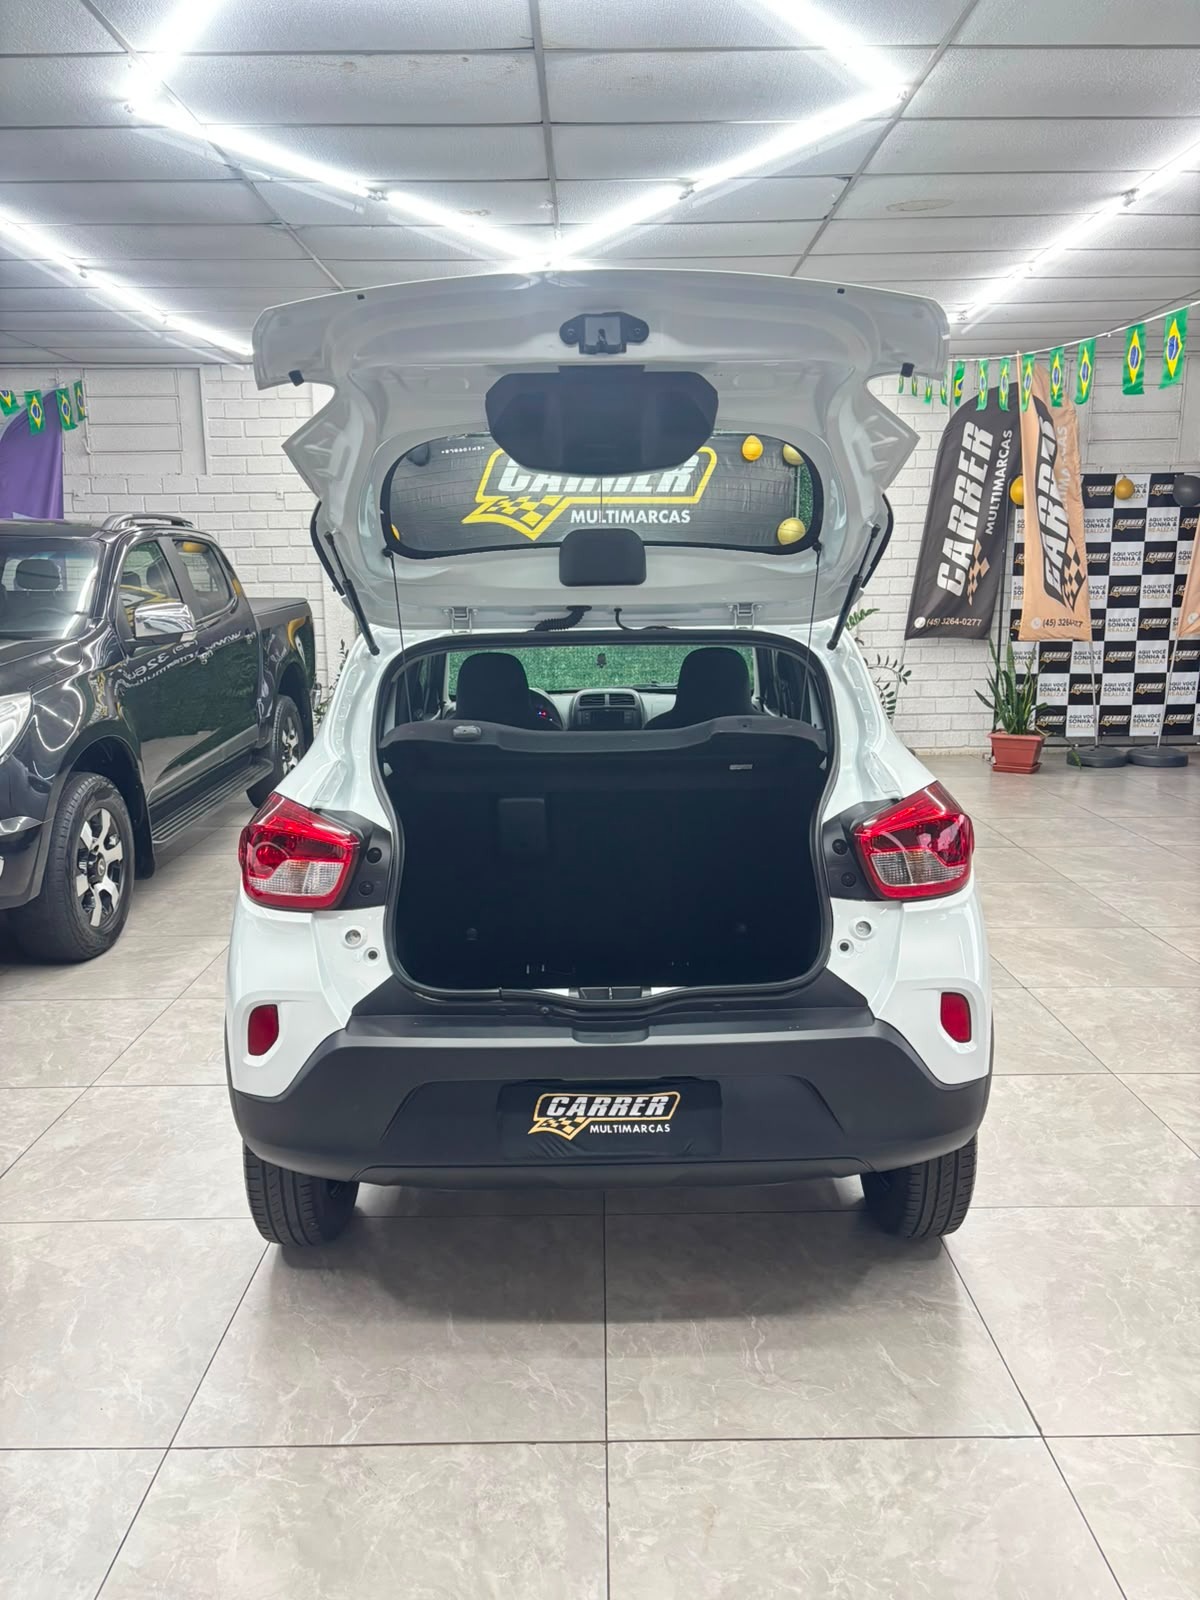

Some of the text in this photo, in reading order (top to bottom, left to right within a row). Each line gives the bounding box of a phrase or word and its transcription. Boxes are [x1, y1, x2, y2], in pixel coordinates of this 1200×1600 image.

[985, 429, 1013, 536] MULTIMARCAS
[570, 508, 691, 525] MULTIMARCAS
[936, 420, 994, 597] CARRER
[926, 617, 983, 626] (45) 3264-0277
[1042, 618, 1057, 628] (45)
[546, 1095, 670, 1117] CARRER
[589, 1123, 671, 1134] MULTIMARCAS
